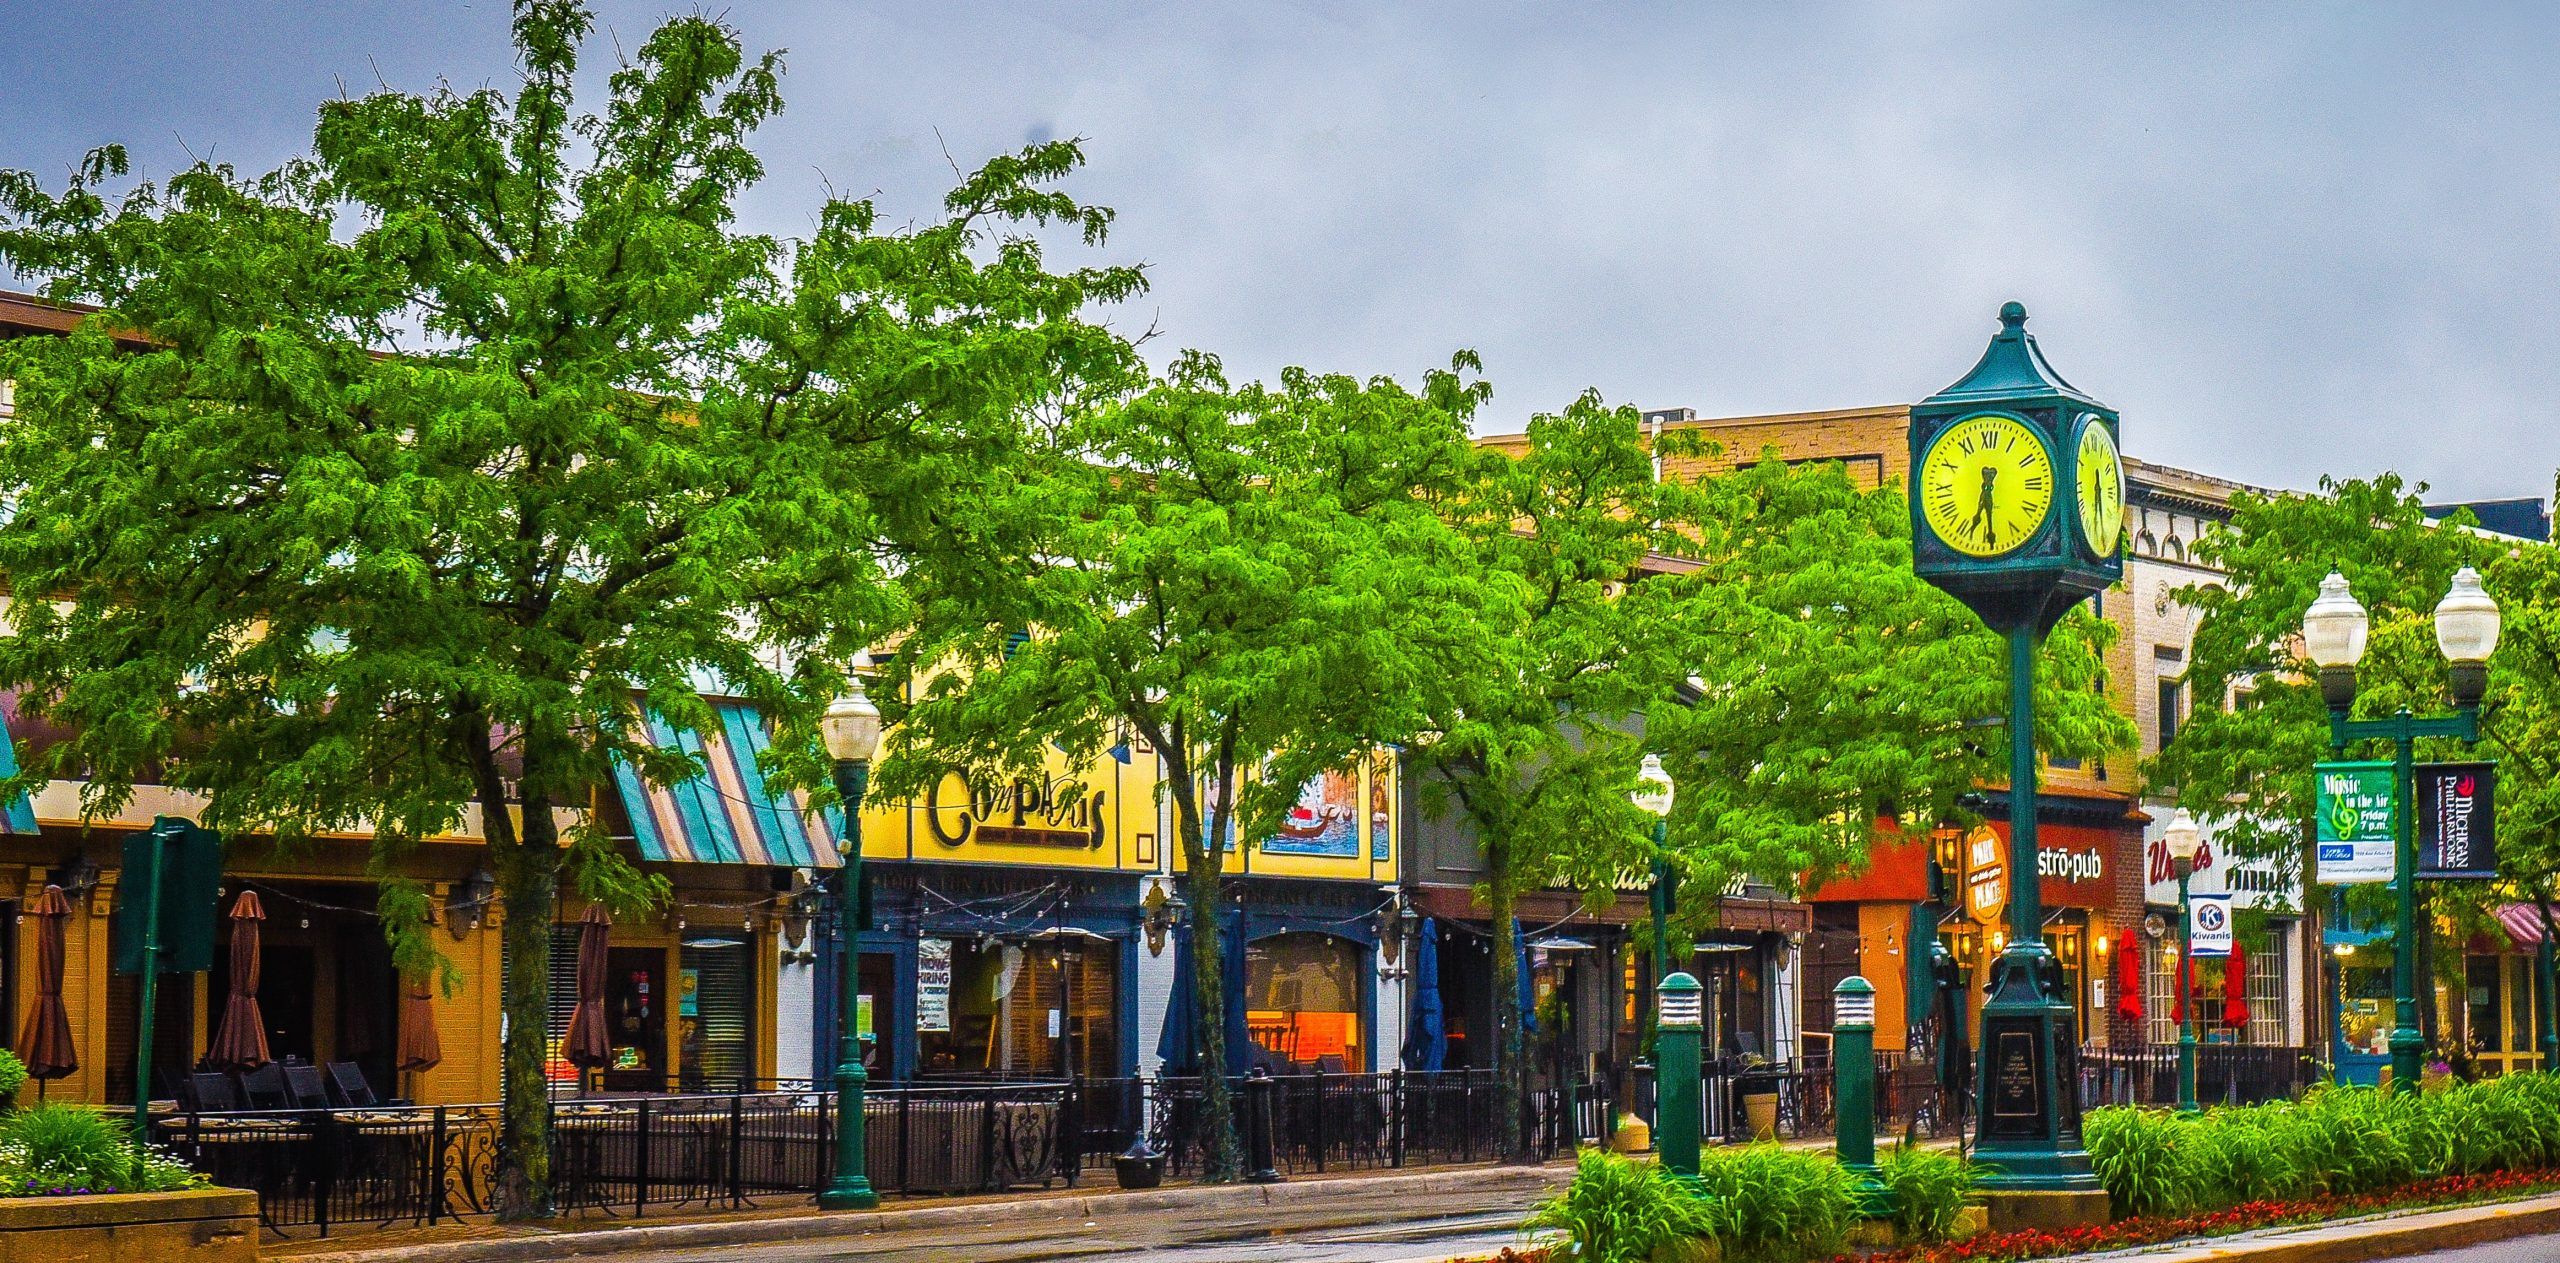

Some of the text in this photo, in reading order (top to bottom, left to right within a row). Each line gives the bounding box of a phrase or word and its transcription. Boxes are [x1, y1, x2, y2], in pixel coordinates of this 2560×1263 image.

[1958, 436, 1974, 458] XI
[1981, 431, 1998, 449] XII
[1941, 458, 1958, 474] X
[2025, 477, 2042, 490] III
[2324, 774, 2361, 795] Music
[2346, 793, 2389, 808] in the Air
[2360, 810, 2389, 822] Friday
[2445, 776, 2457, 869] PHILHARMONIC
[2360, 822, 2389, 833] 7 p.m.
[2456, 797, 2473, 868] MICHIGAN
[1974, 879, 2002, 911] PLACE
[2191, 932, 2231, 940] Kiwanis
